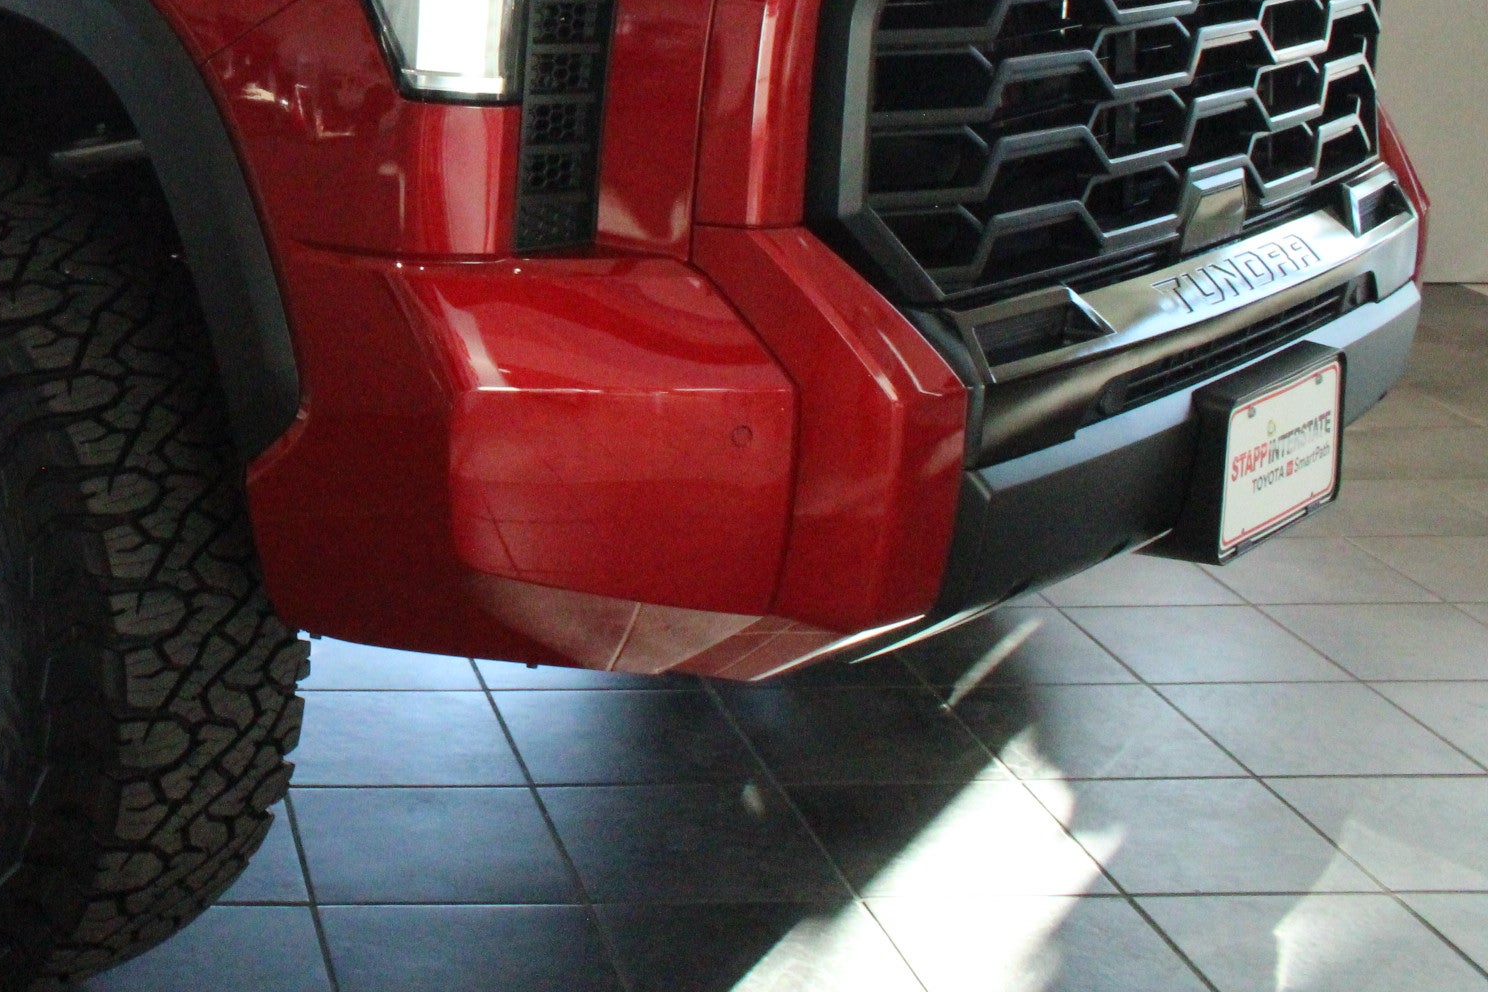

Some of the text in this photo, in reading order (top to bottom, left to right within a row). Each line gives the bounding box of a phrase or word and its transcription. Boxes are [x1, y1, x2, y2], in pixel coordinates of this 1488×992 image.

[1151, 233, 1321, 314] TUNDRA
[1231, 442, 1268, 483] STAPP
[1251, 465, 1285, 494] TOYOTA
